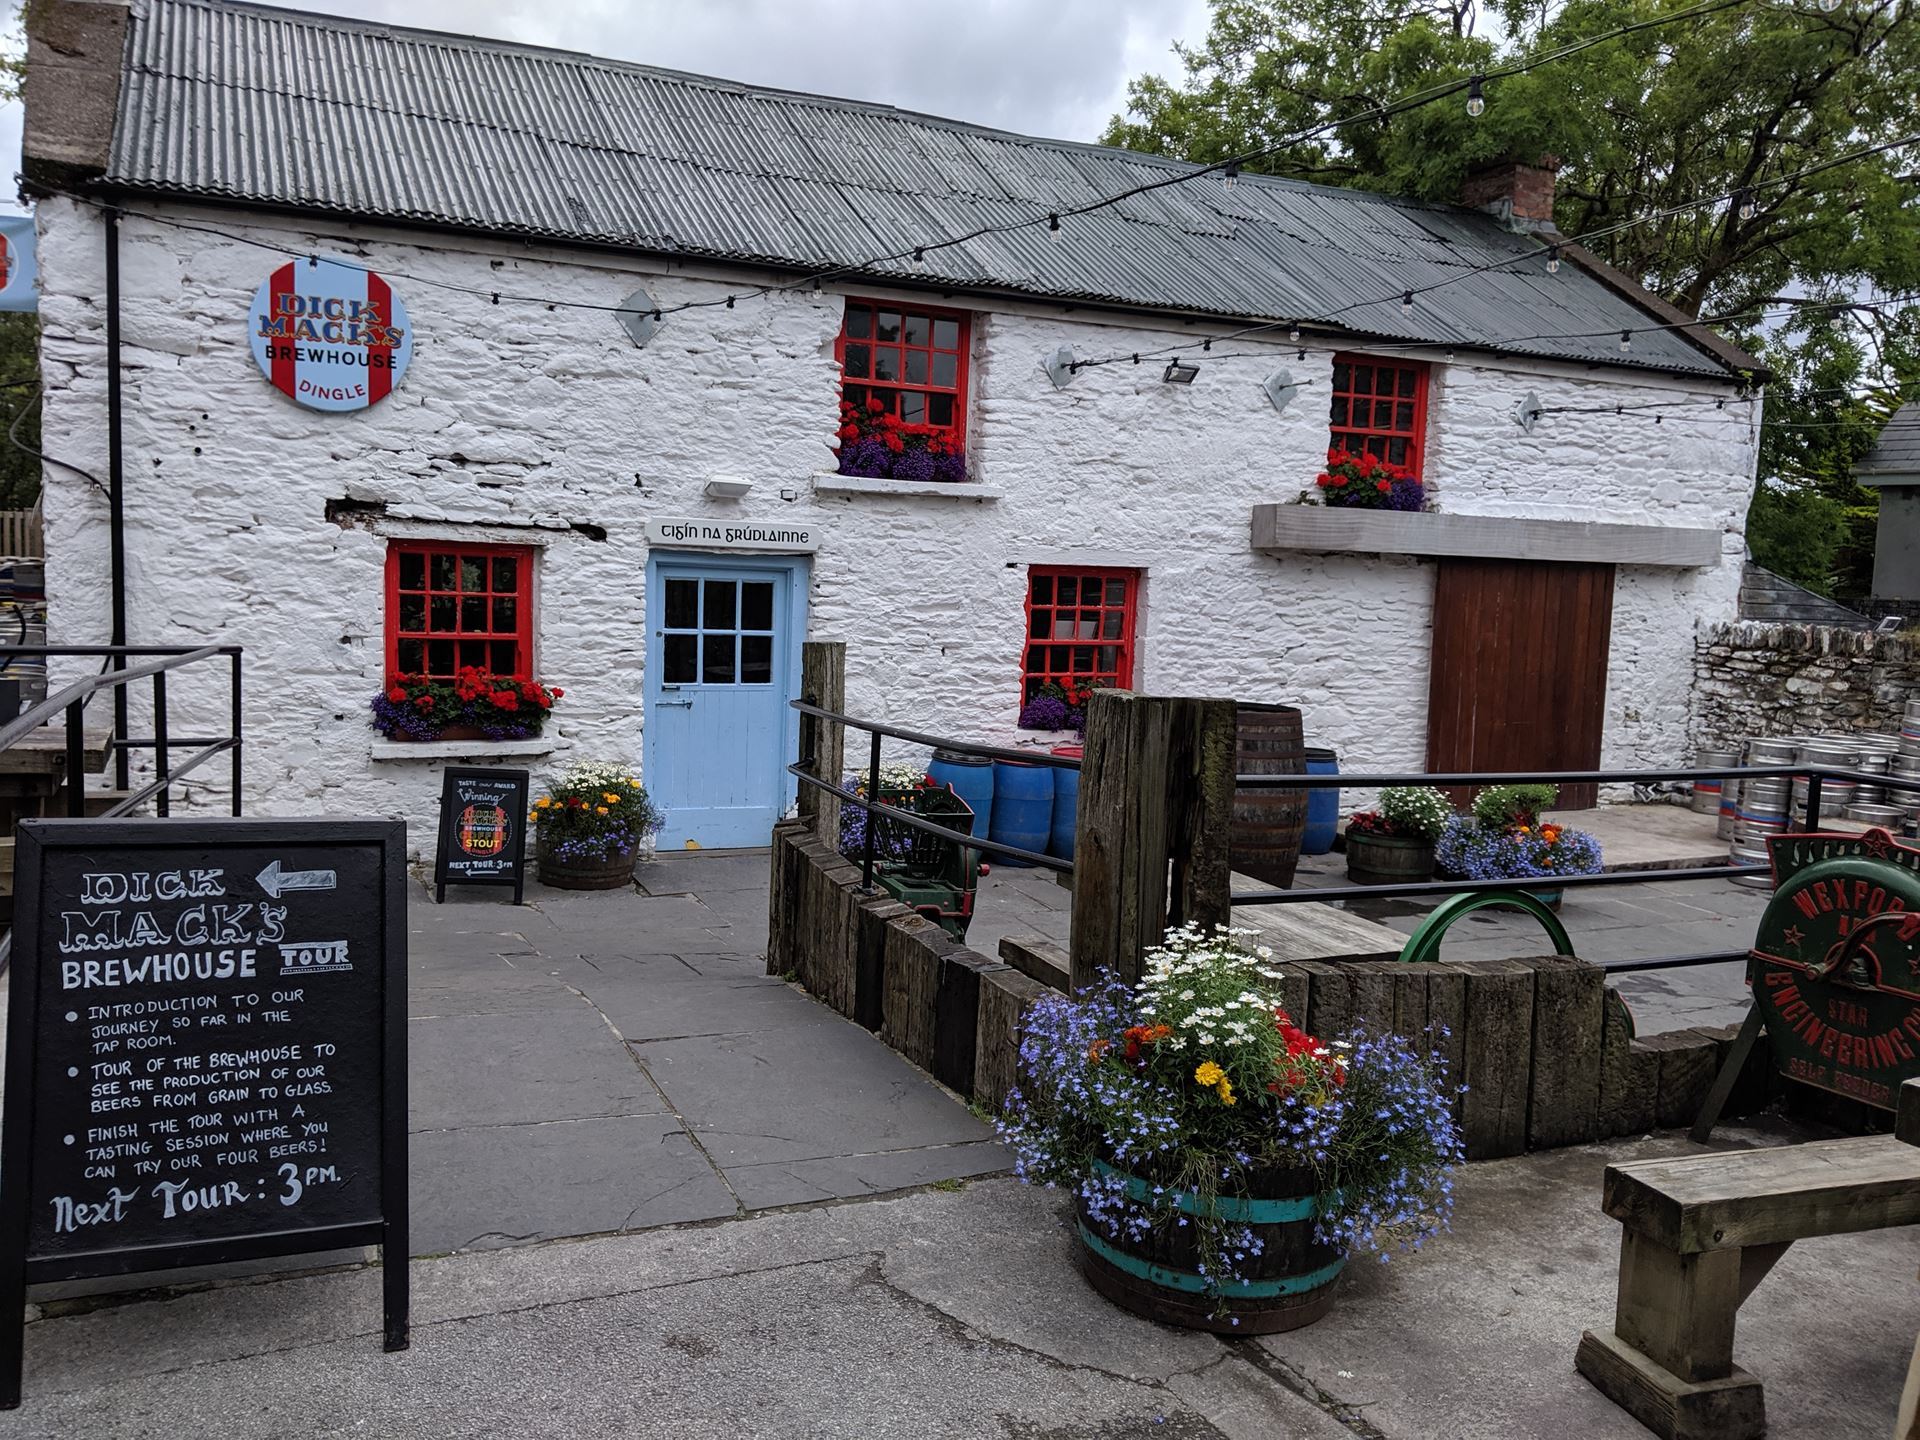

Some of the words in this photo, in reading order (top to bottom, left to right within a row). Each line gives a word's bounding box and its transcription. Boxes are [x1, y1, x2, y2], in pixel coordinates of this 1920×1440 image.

[277, 292, 382, 324] DICK
[257, 314, 405, 349] MACK'S
[265, 345, 397, 369] BREWHOUSE
[299, 380, 366, 400] DINGLE
[457, 788, 509, 806] Winning
[466, 839, 500, 848] STOUT
[449, 861, 471, 869] NEXT
[81, 869, 226, 904] DICK
[59, 902, 288, 953] MACK'S
[62, 949, 257, 989] BREWHOUSE
[280, 945, 350, 967] TOUR
[88, 995, 217, 1020] INTRODUCTION
[232, 993, 259, 1008] TO
[272, 988, 304, 1003] OUR
[1828, 999, 1868, 1028] STAR
[91, 1019, 159, 1039] JOURNEY
[172, 1016, 191, 1028] SO
[200, 1013, 227, 1027] FAR
[237, 1012, 251, 1024] IN
[262, 1010, 291, 1023] THE
[1764, 971, 1917, 1071] ENGINEERING
[92, 1040, 119, 1055] TAP
[127, 1035, 177, 1050] ROOM.
[91, 1060, 132, 1080] TOUR
[146, 1058, 166, 1073] OF
[173, 1055, 201, 1070] THE
[209, 1045, 302, 1068] BREWHOUSE
[313, 1043, 336, 1057] TO
[91, 1081, 121, 1098] SEE
[129, 1079, 154, 1091] THE
[163, 1067, 260, 1089] PRODUCTION
[271, 1067, 289, 1080] OF
[296, 1065, 325, 1078] OUR
[91, 1097, 141, 1113] BEERS
[153, 1093, 197, 1108] FROM
[208, 1088, 250, 1104] GRAIN
[258, 1086, 278, 1099] TO
[285, 1081, 333, 1097] GLASS.
[87, 1123, 138, 1143] FINISH
[148, 1119, 178, 1134] THE
[187, 1113, 223, 1129] TOUR
[233, 1111, 278, 1127] WITH
[291, 1104, 305, 1118] A
[84, 1164, 115, 1179] CAN
[133, 1159, 162, 1178] TRY
[170, 1155, 202, 1170] OUR
[216, 1149, 258, 1166] FOUR
[269, 1138, 327, 1160] BEERS!
[85, 1142, 153, 1161] TASTING
[166, 1132, 229, 1151] SESSION
[241, 1125, 292, 1144] WHERE
